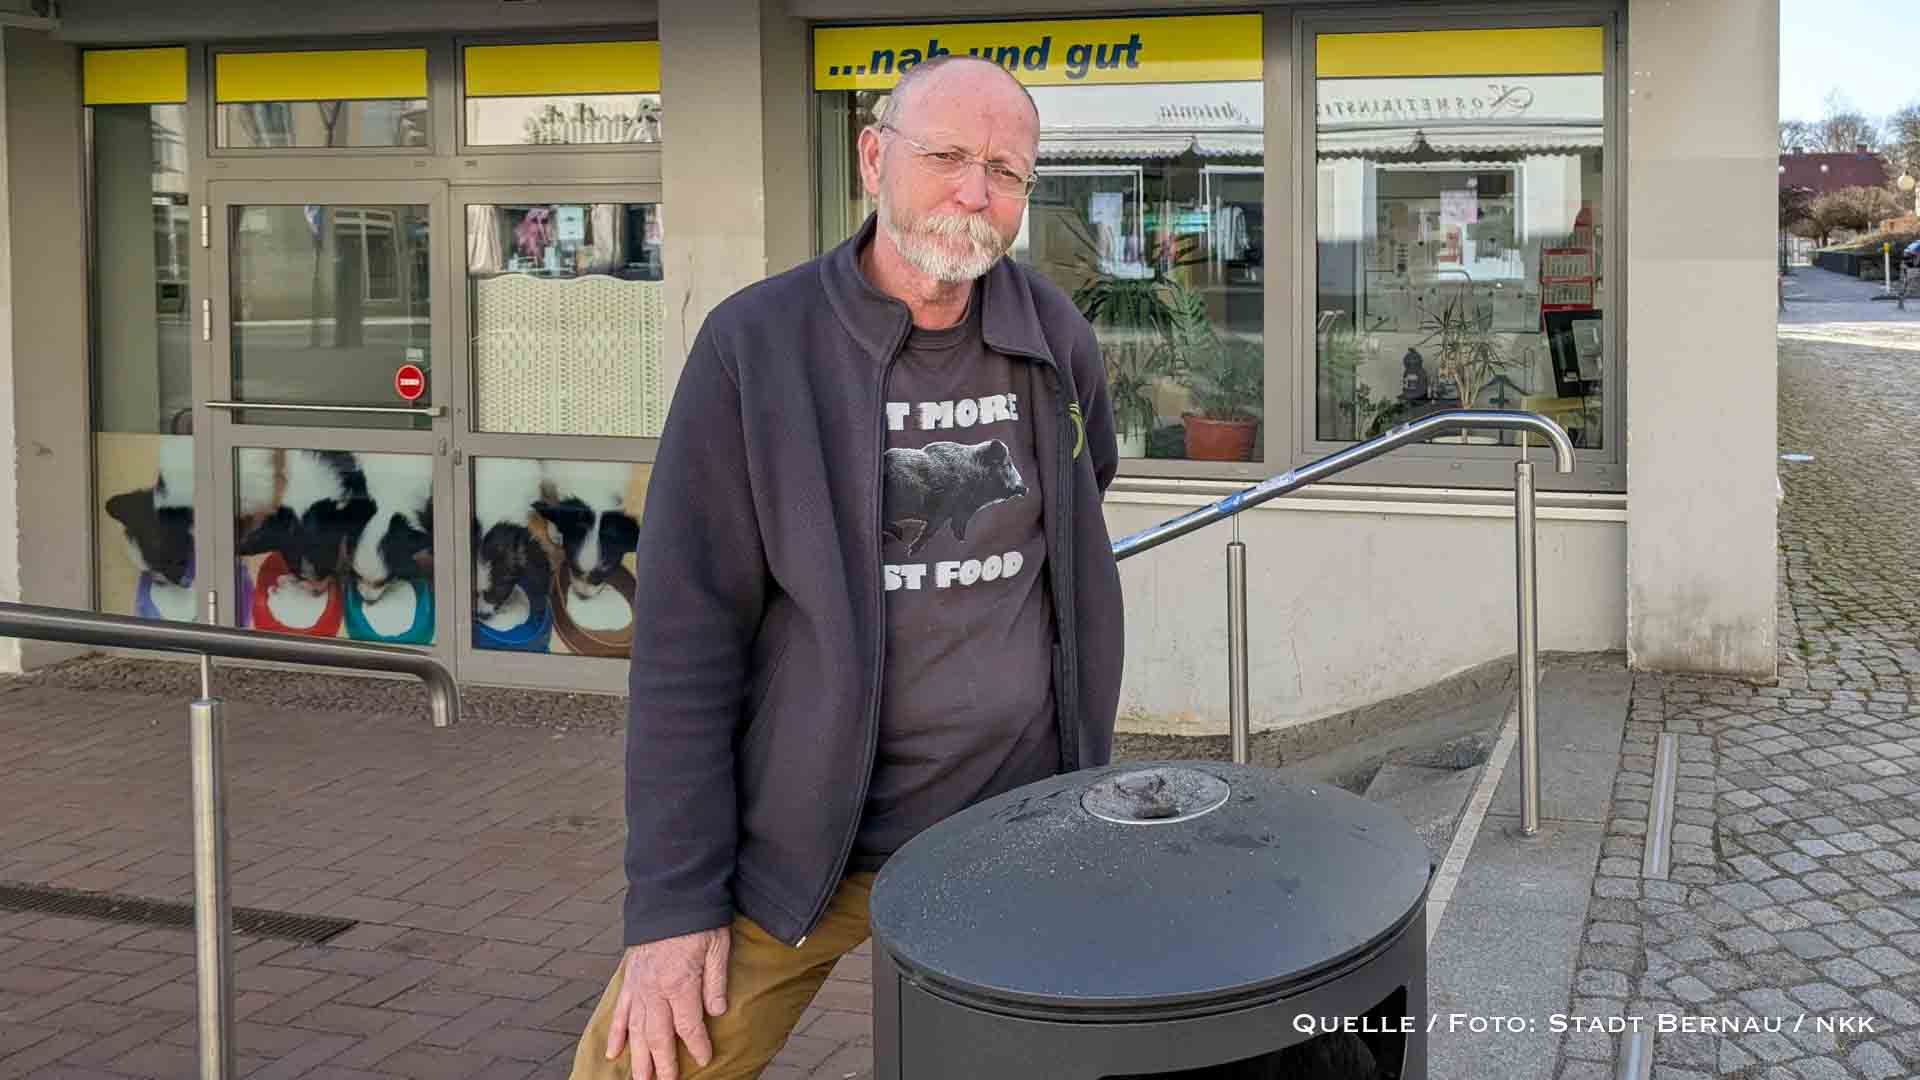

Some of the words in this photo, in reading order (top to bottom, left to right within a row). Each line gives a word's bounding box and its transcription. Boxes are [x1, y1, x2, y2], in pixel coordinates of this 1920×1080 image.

[1065, 33, 1142, 80] gut
[917, 393, 1019, 430] MORE
[884, 563, 927, 591] ST
[935, 551, 1024, 588] FOOD
